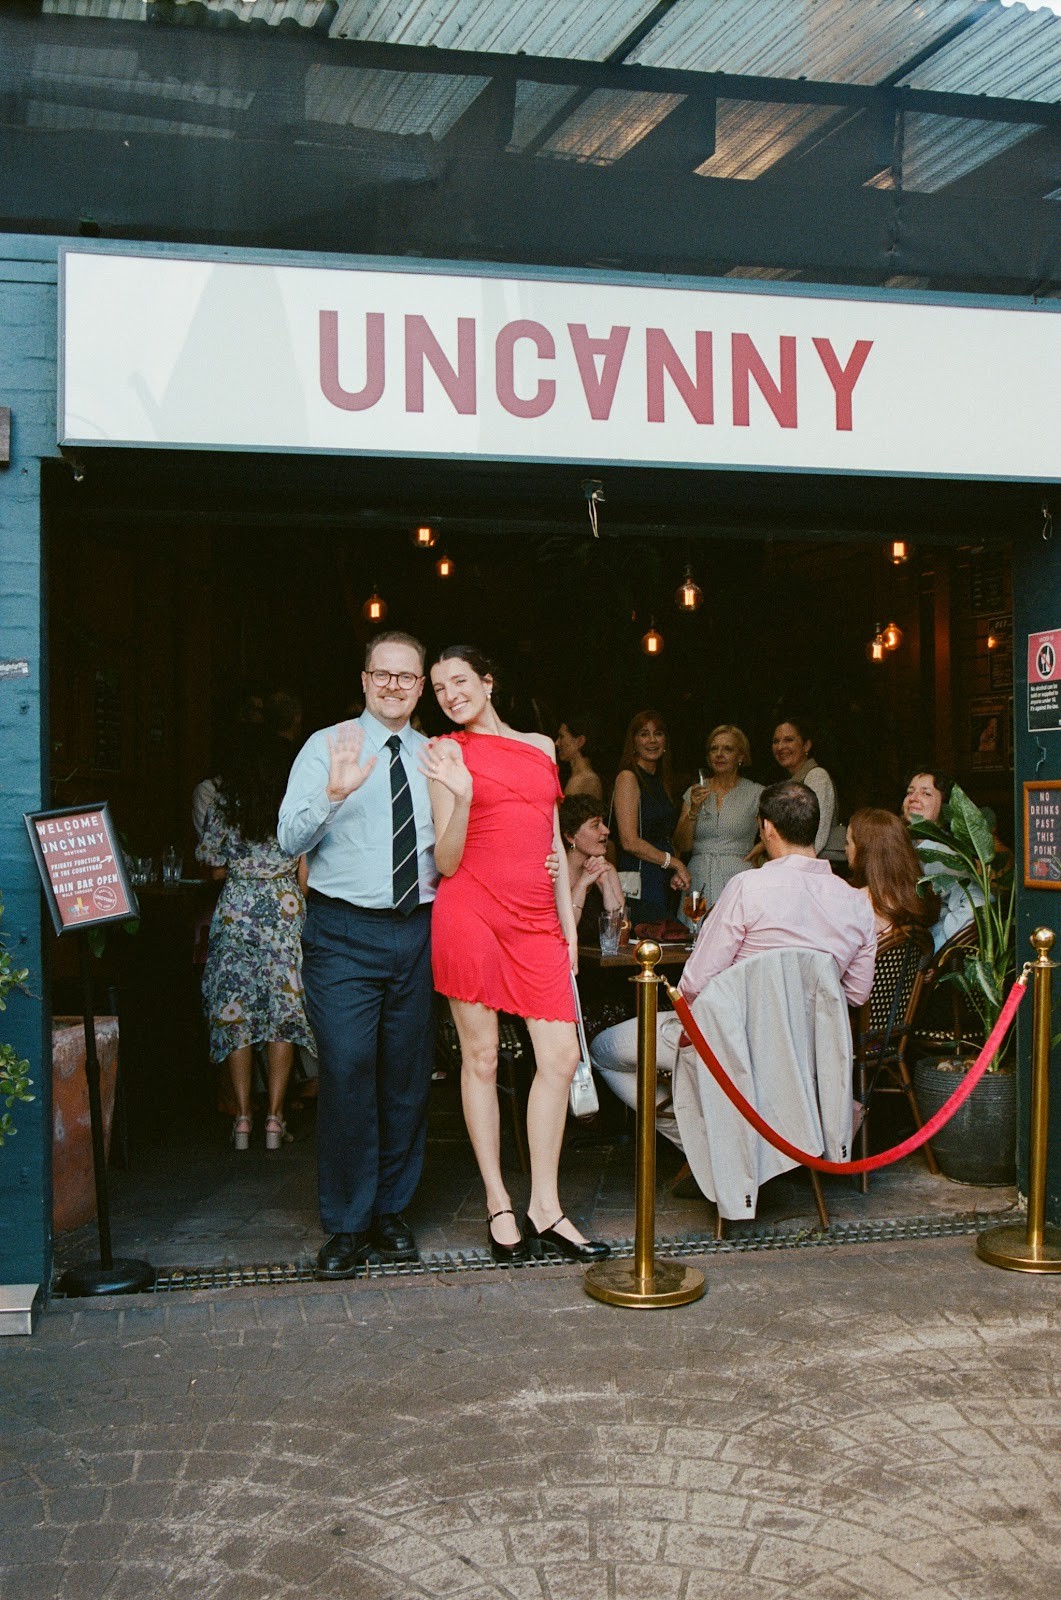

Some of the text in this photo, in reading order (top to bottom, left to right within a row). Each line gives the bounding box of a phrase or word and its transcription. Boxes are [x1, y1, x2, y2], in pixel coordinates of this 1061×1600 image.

[1040, 792, 1050, 801] NO
[1031, 806, 1059, 815] DRINKS
[36, 816, 98, 835] WELCOME
[1036, 819, 1054, 828] PAST
[1037, 832, 1054, 842] THIS
[1034, 846, 1056, 855] POINT
[51, 856, 100, 870] PRIVATE FUNCTION
[71, 864, 103, 875] COURTYARD
[77, 879, 94, 889] BAR
[97, 874, 118, 886] OPEN
